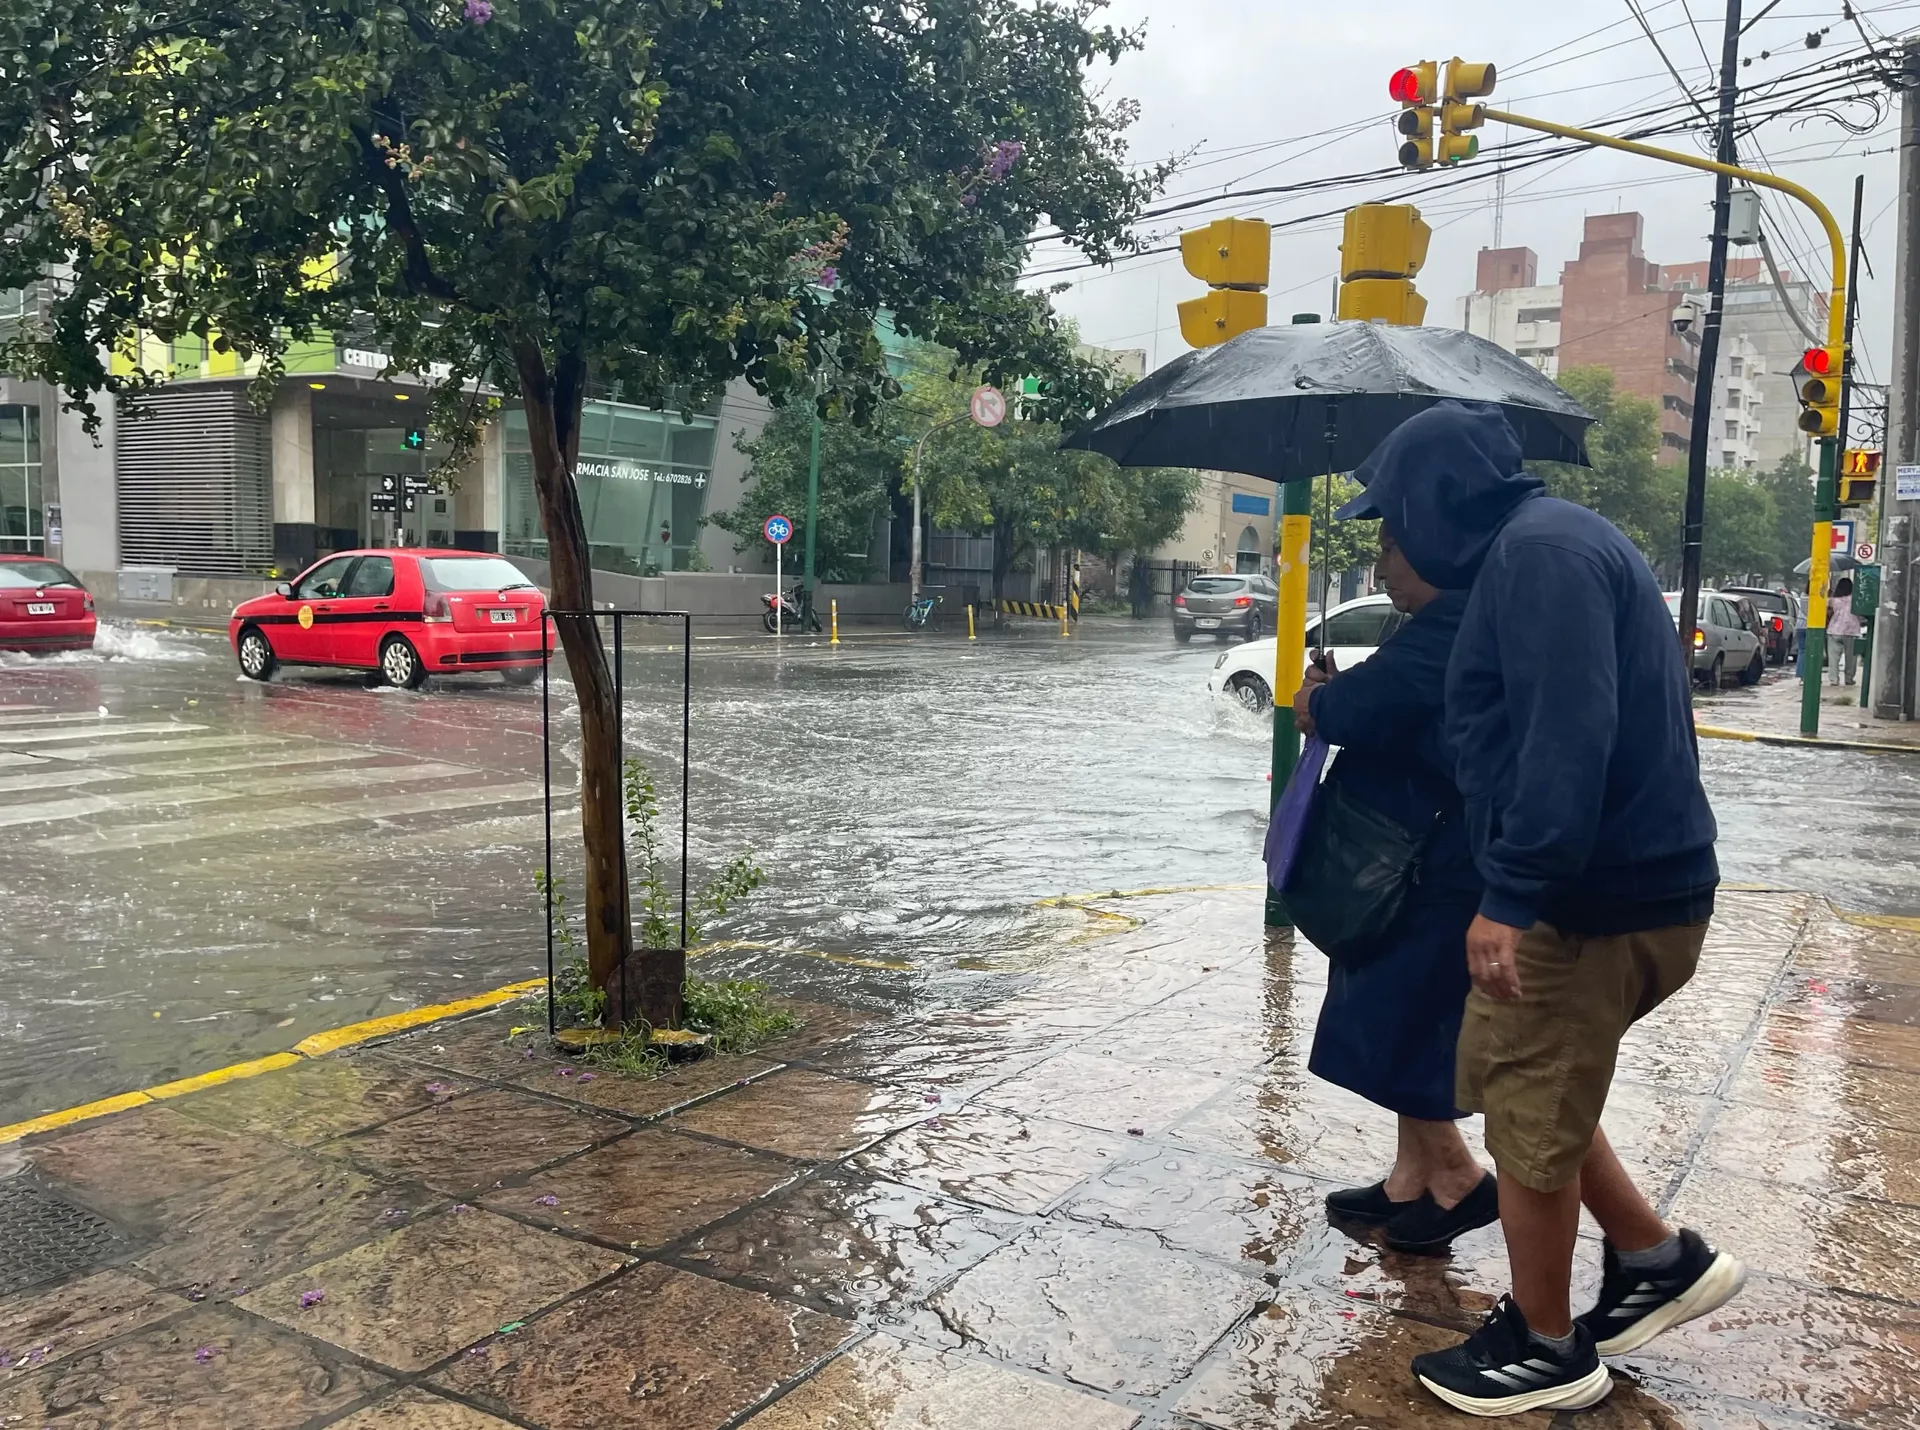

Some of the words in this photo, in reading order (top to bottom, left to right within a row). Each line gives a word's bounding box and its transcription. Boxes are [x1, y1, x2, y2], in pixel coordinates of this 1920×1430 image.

[343, 348, 388, 369] CENTRO
[576, 462, 609, 478] RMACIA
[610, 466, 628, 479] SAN
[629, 468, 650, 481] JOSE
[665, 473, 692, 485] 6702826
